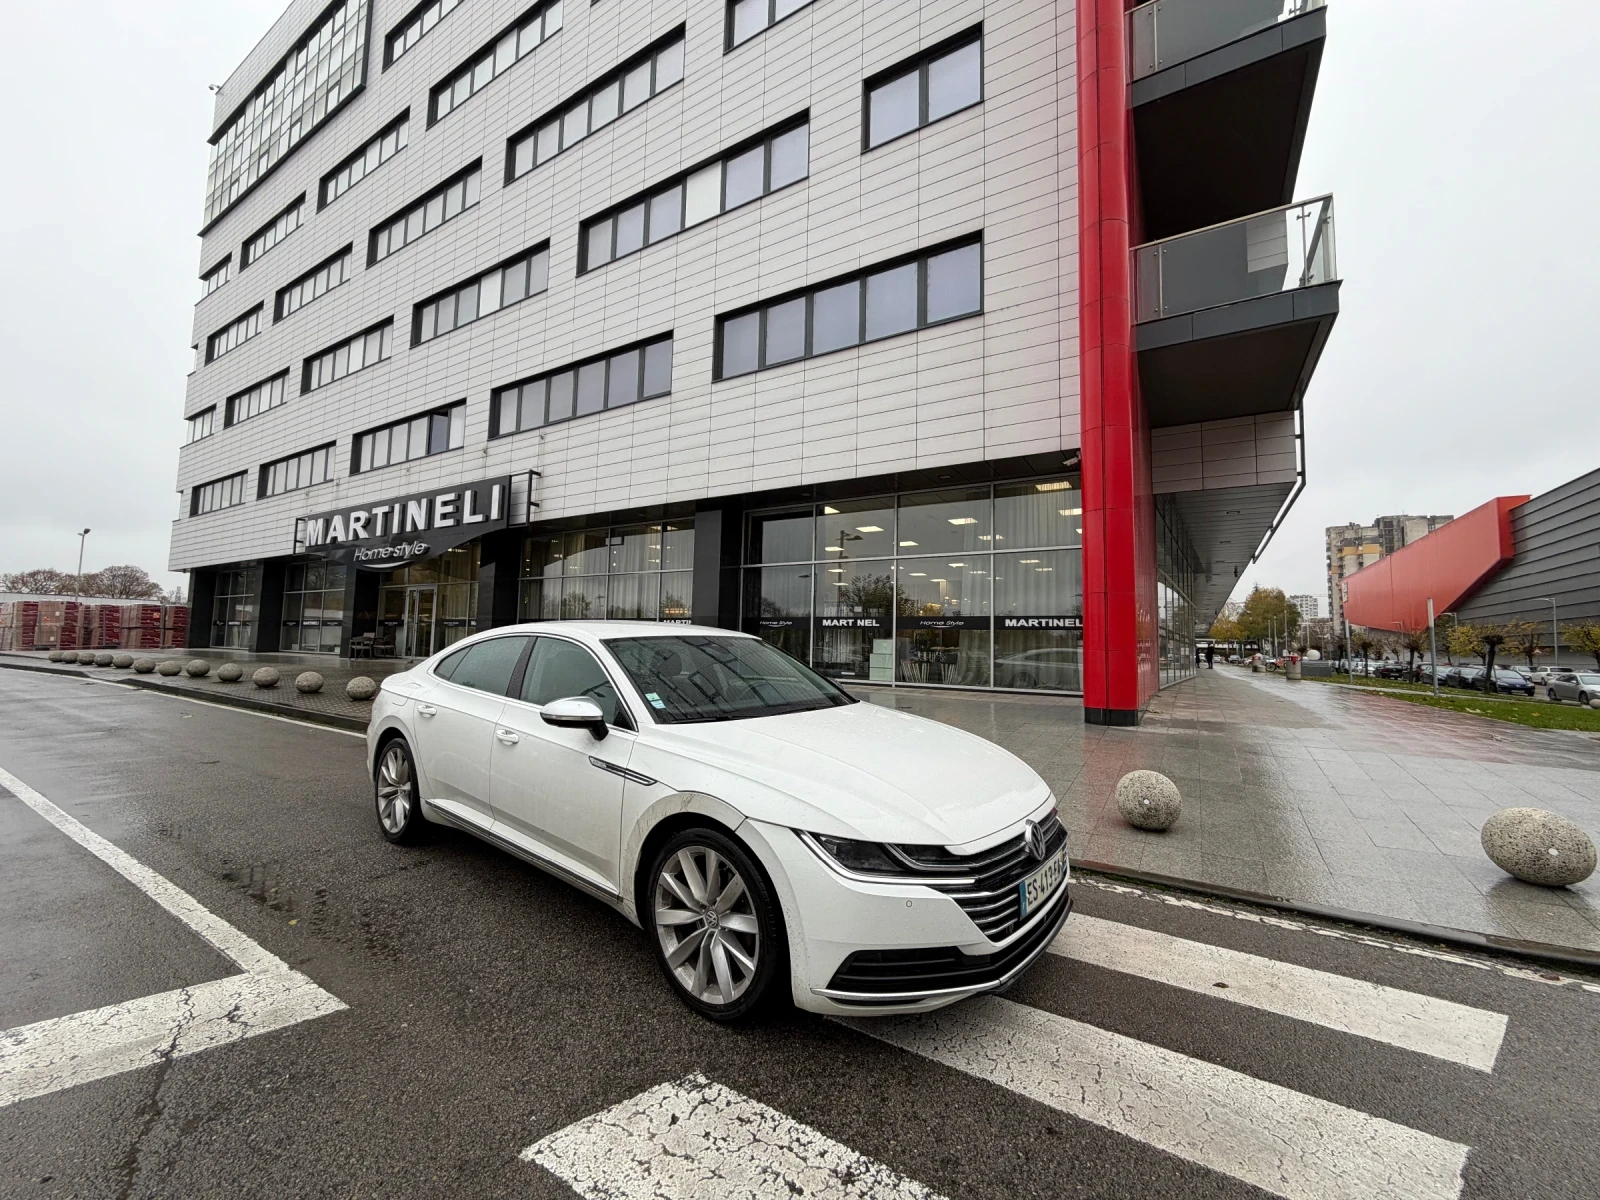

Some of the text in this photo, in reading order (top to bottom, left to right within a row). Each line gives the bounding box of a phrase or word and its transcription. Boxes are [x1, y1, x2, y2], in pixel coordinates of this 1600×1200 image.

[305, 484, 504, 547] MARTINELI
[353, 540, 427, 561] Home style
[1005, 618, 1083, 627] MARTINEL
